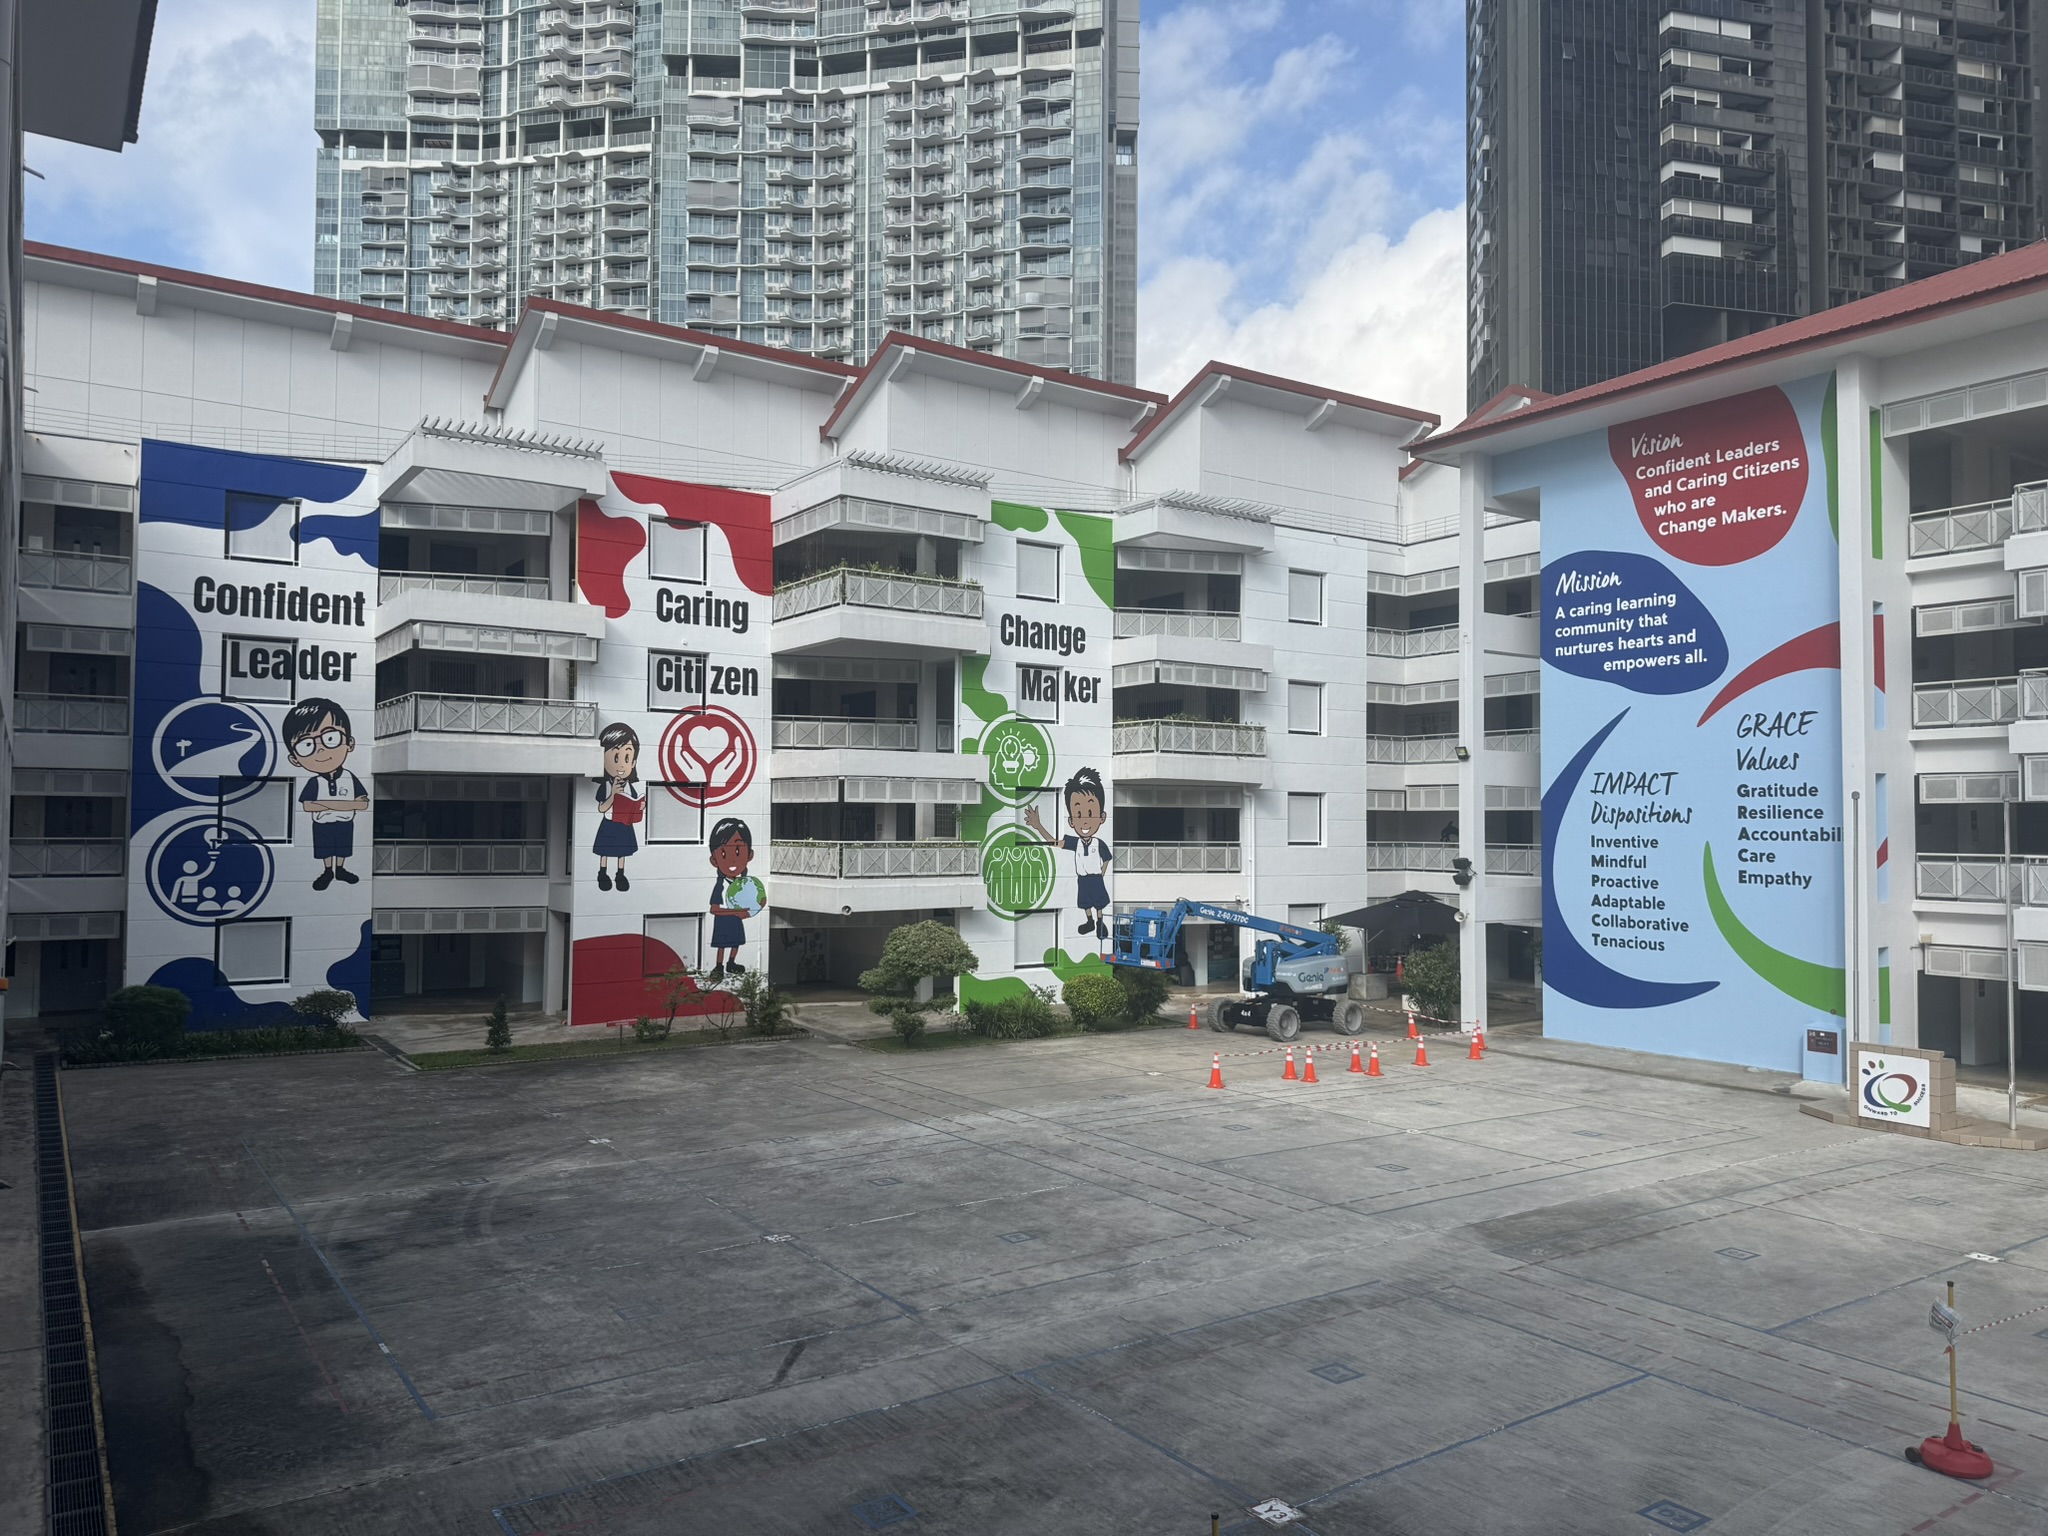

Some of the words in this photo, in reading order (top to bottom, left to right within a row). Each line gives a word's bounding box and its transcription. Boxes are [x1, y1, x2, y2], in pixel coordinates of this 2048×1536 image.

[1631, 432, 1684, 459] Vision
[1635, 452, 1712, 481] Confident
[1716, 440, 1780, 463] Leaders
[1644, 481, 1672, 499] and
[1676, 472, 1728, 493] Caring
[1732, 457, 1801, 482] Citizens
[1654, 501, 1687, 517] who
[1690, 496, 1716, 510] are
[1658, 515, 1717, 537] Change
[1722, 504, 1787, 525] Makers.
[1555, 570, 1623, 597] Mission
[193, 576, 366, 627] Confident
[656, 587, 750, 634] Caring
[1555, 606, 1566, 620] A
[1569, 601, 1612, 619] caring
[1616, 592, 1677, 612] learning
[1000, 613, 1087, 657] Change
[1555, 618, 1634, 639] community
[1638, 613, 1669, 629] that
[1555, 640, 1615, 658] nurtures
[1618, 634, 1665, 652] hearts
[1668, 629, 1697, 645] and
[230, 641, 358, 682] Leader
[1603, 654, 1681, 673] empowers
[1685, 649, 1708, 664] all.
[656, 657, 759, 697] Citizen
[1021, 668, 1102, 704] Maker
[1737, 711, 1819, 739] GRACE
[1737, 747, 1800, 771] Values
[1590, 772, 1680, 797] IMPACT
[1736, 783, 1820, 799] Gratitude
[1590, 801, 1694, 830] Dispositions
[1737, 805, 1825, 821] Resilience
[1590, 835, 1660, 850] Inventive
[1591, 855, 1648, 870] Mindful
[1738, 848, 1777, 864] Care
[1591, 874, 1660, 891] Proactive
[1738, 870, 1812, 889] Empathy
[1200, 906, 1216, 917] Genie
[1590, 894, 1666, 912] Adaptable
[1591, 914, 1690, 933] Collaborative
[1591, 933, 1666, 952] Tenacious
[1298, 972, 1325, 983] Genie
[1863, 1104, 1889, 1116] ONWARD
[1913, 1083, 1926, 1107] SUCCESS
[1264, 1505, 1288, 1520] Y3
